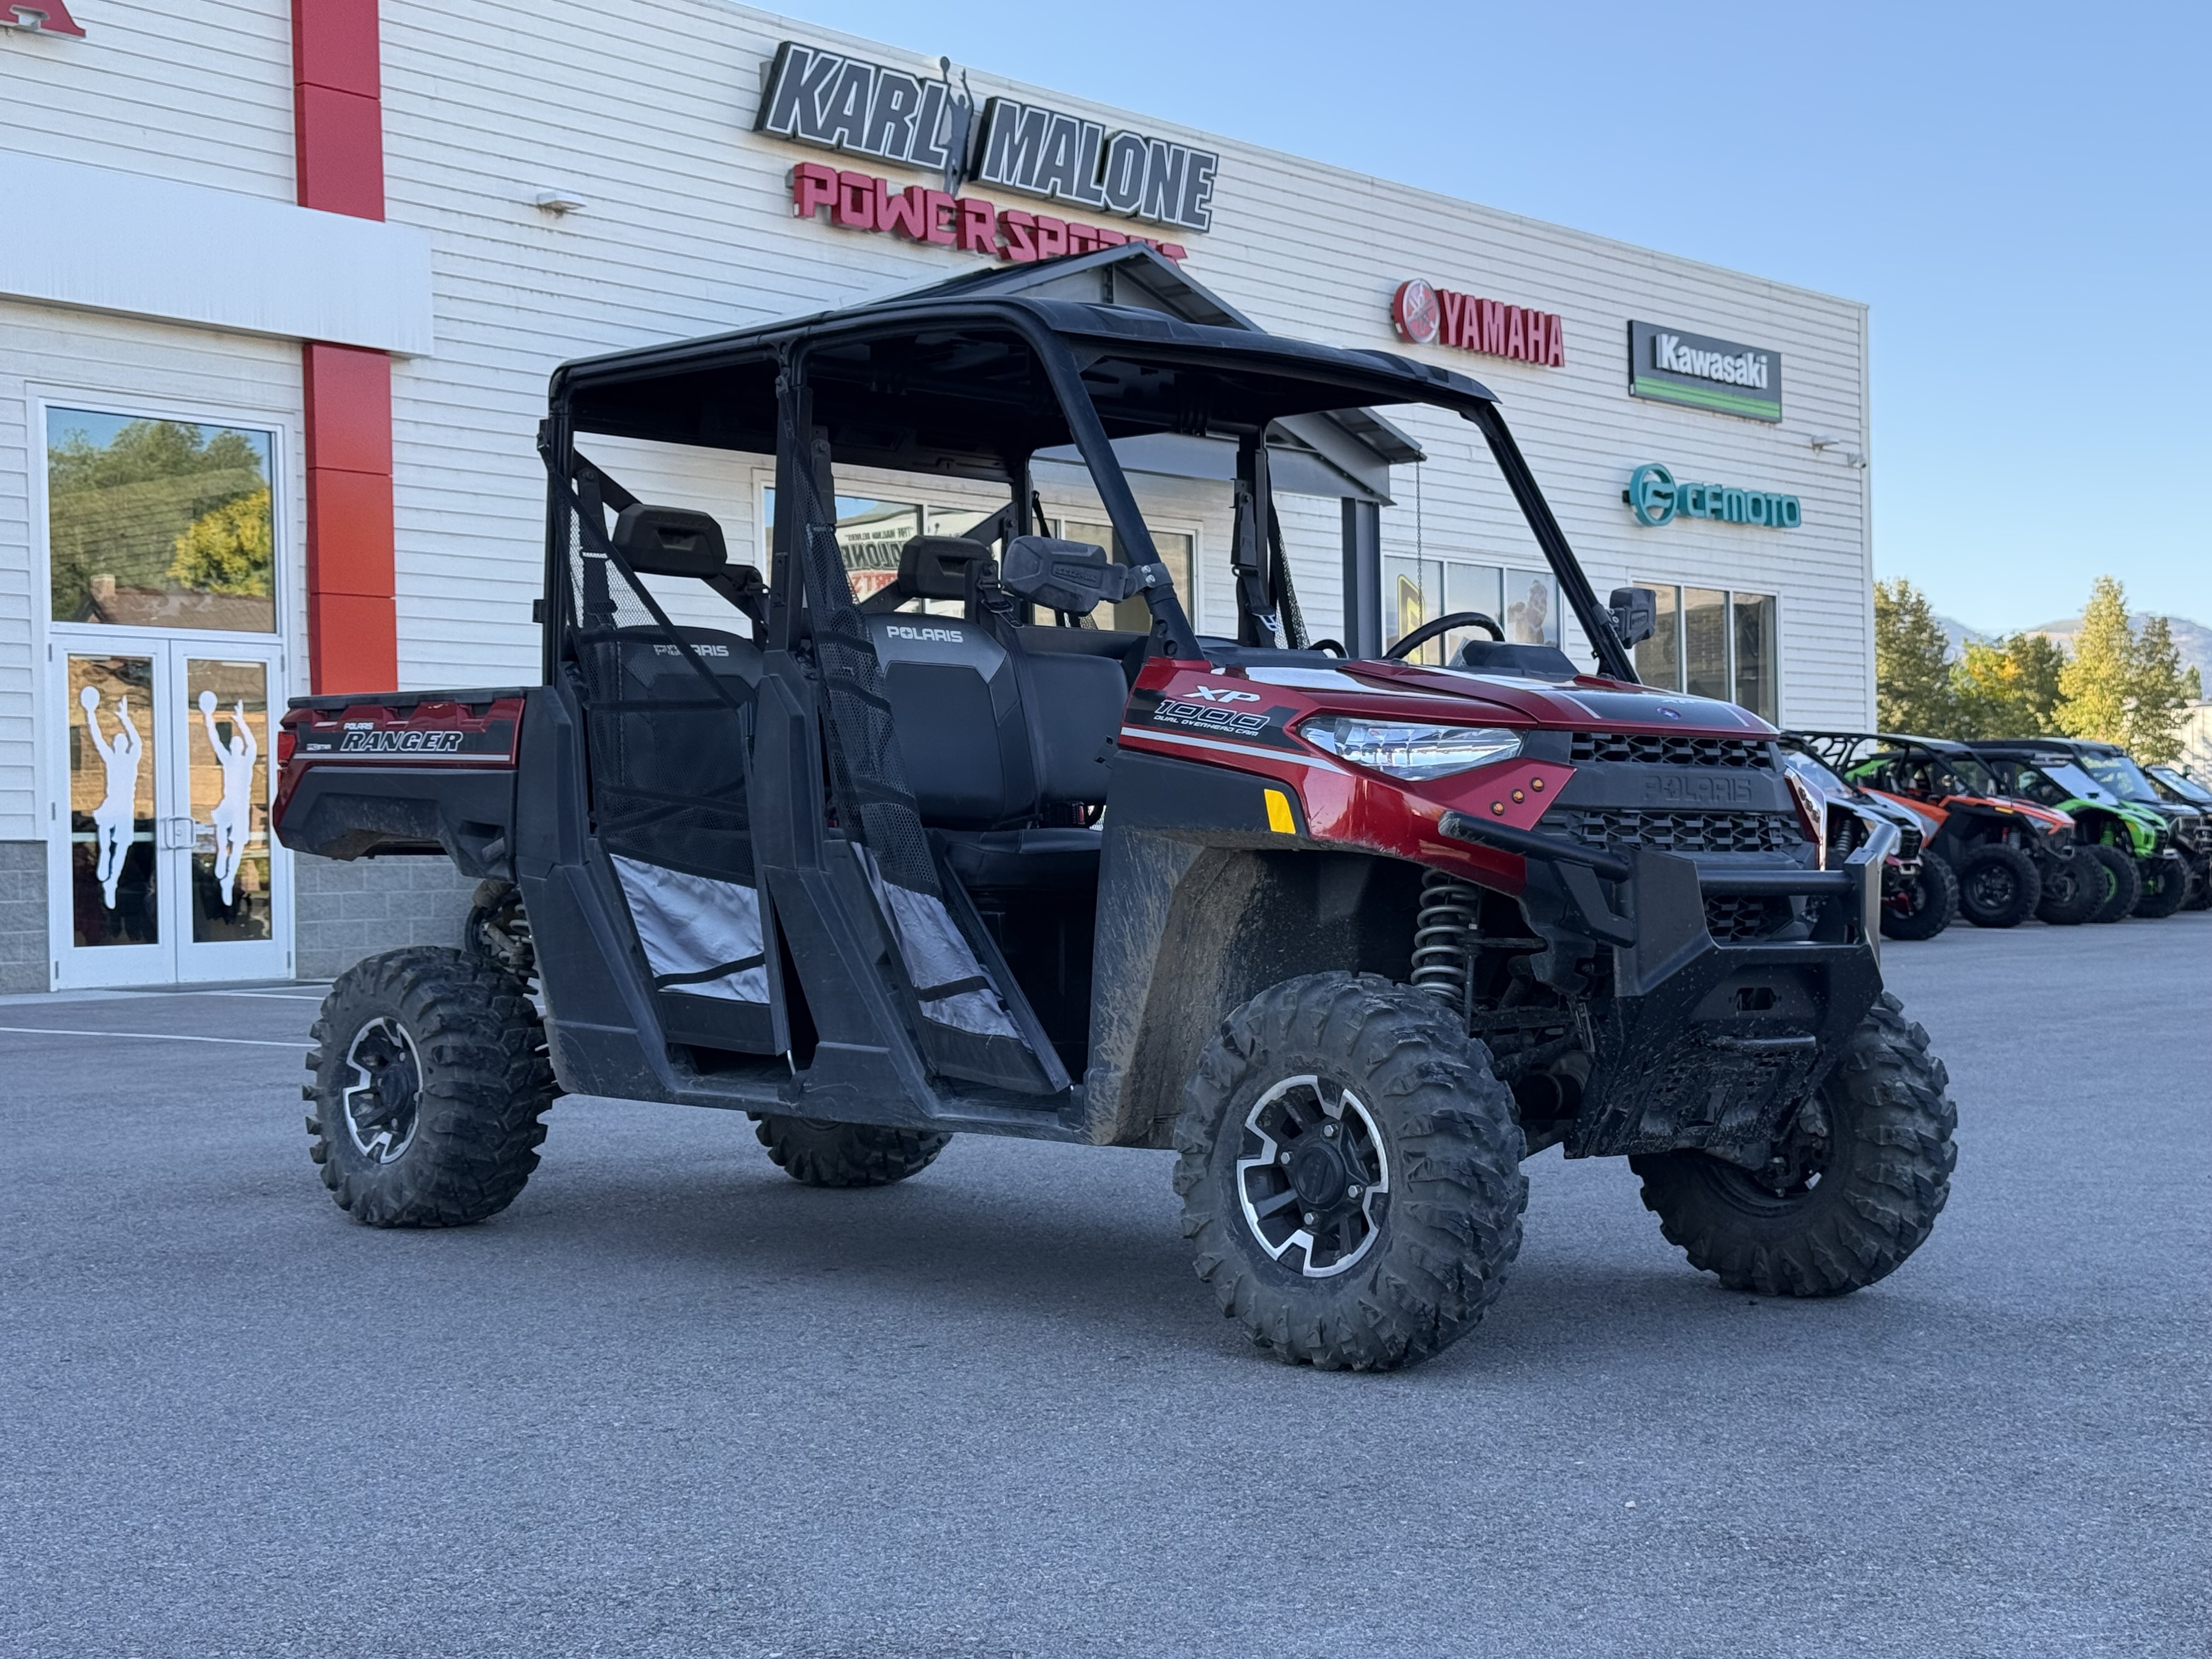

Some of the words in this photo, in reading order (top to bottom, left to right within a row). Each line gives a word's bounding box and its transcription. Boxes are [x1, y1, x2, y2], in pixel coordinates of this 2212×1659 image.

[761, 42, 952, 171] KARL
[981, 97, 1219, 233] MALONE
[1441, 288, 1565, 367] YAMAHA
[1656, 333, 1768, 390] Kawasaki
[1680, 482, 1801, 528] CFMOTO
[887, 625, 963, 643] POLARIS
[653, 644, 729, 657] POARIS
[1181, 685, 1261, 703] XP
[343, 722, 374, 730] POLARIS
[1153, 715, 1179, 724] DUAL
[1181, 720, 1234, 732] OVERHEAD
[1235, 728, 1259, 737] CAM
[1154, 699, 1271, 731] 1000
[340, 731, 464, 752] RANGER
[1644, 775, 1752, 803] POLARIS
